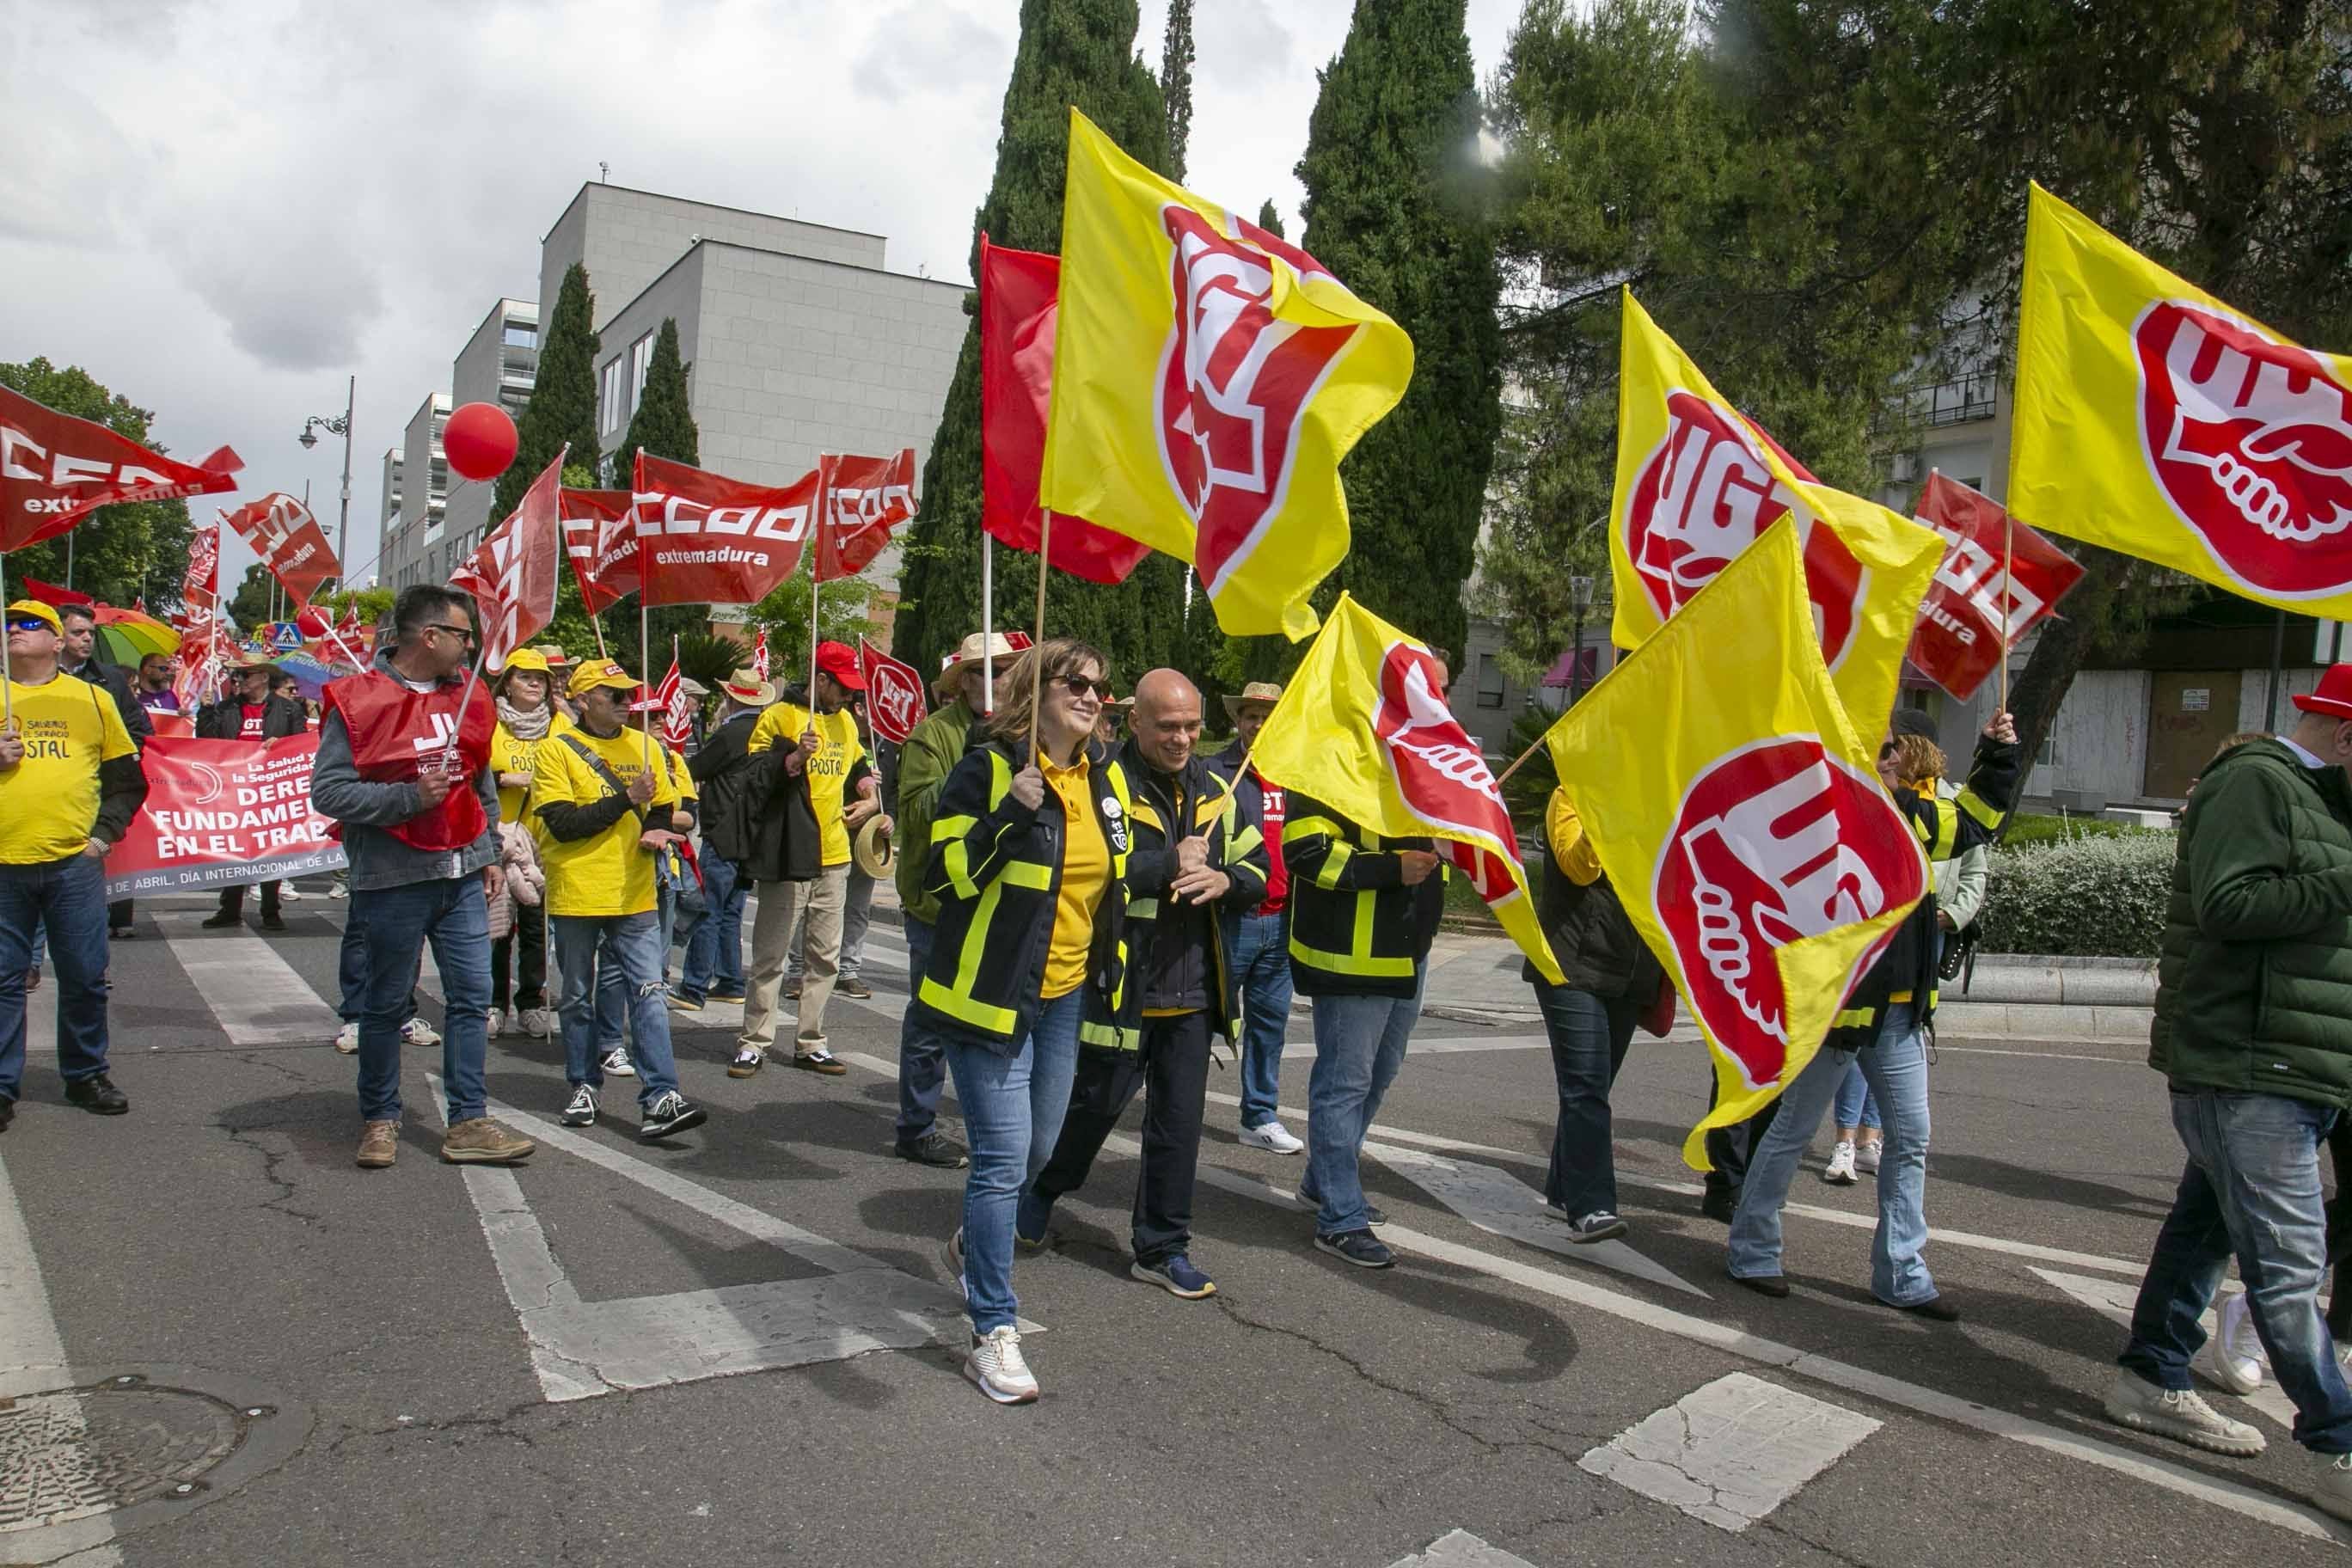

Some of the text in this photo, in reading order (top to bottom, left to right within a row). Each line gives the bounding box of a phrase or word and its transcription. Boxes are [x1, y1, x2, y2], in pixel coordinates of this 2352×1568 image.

[633, 492, 808, 542] CCOO
[656, 546, 769, 567] extremadura
[243, 719, 263, 730] GT
[27, 740, 70, 760] STAL
[248, 763, 264, 773] La
[267, 753, 305, 770] Salud
[811, 757, 846, 777] POSTAL
[232, 773, 246, 784] la
[1263, 792, 1283, 812] GT
[156, 835, 199, 859] EN
[208, 834, 245, 853] EL
[1720, 758, 1884, 939] UG
[115, 880, 132, 892] DE
[180, 869, 202, 884] DÍA
[205, 860, 303, 880] INTERNACIONAL
[306, 855, 324, 867] DE
[327, 852, 344, 865] LA
